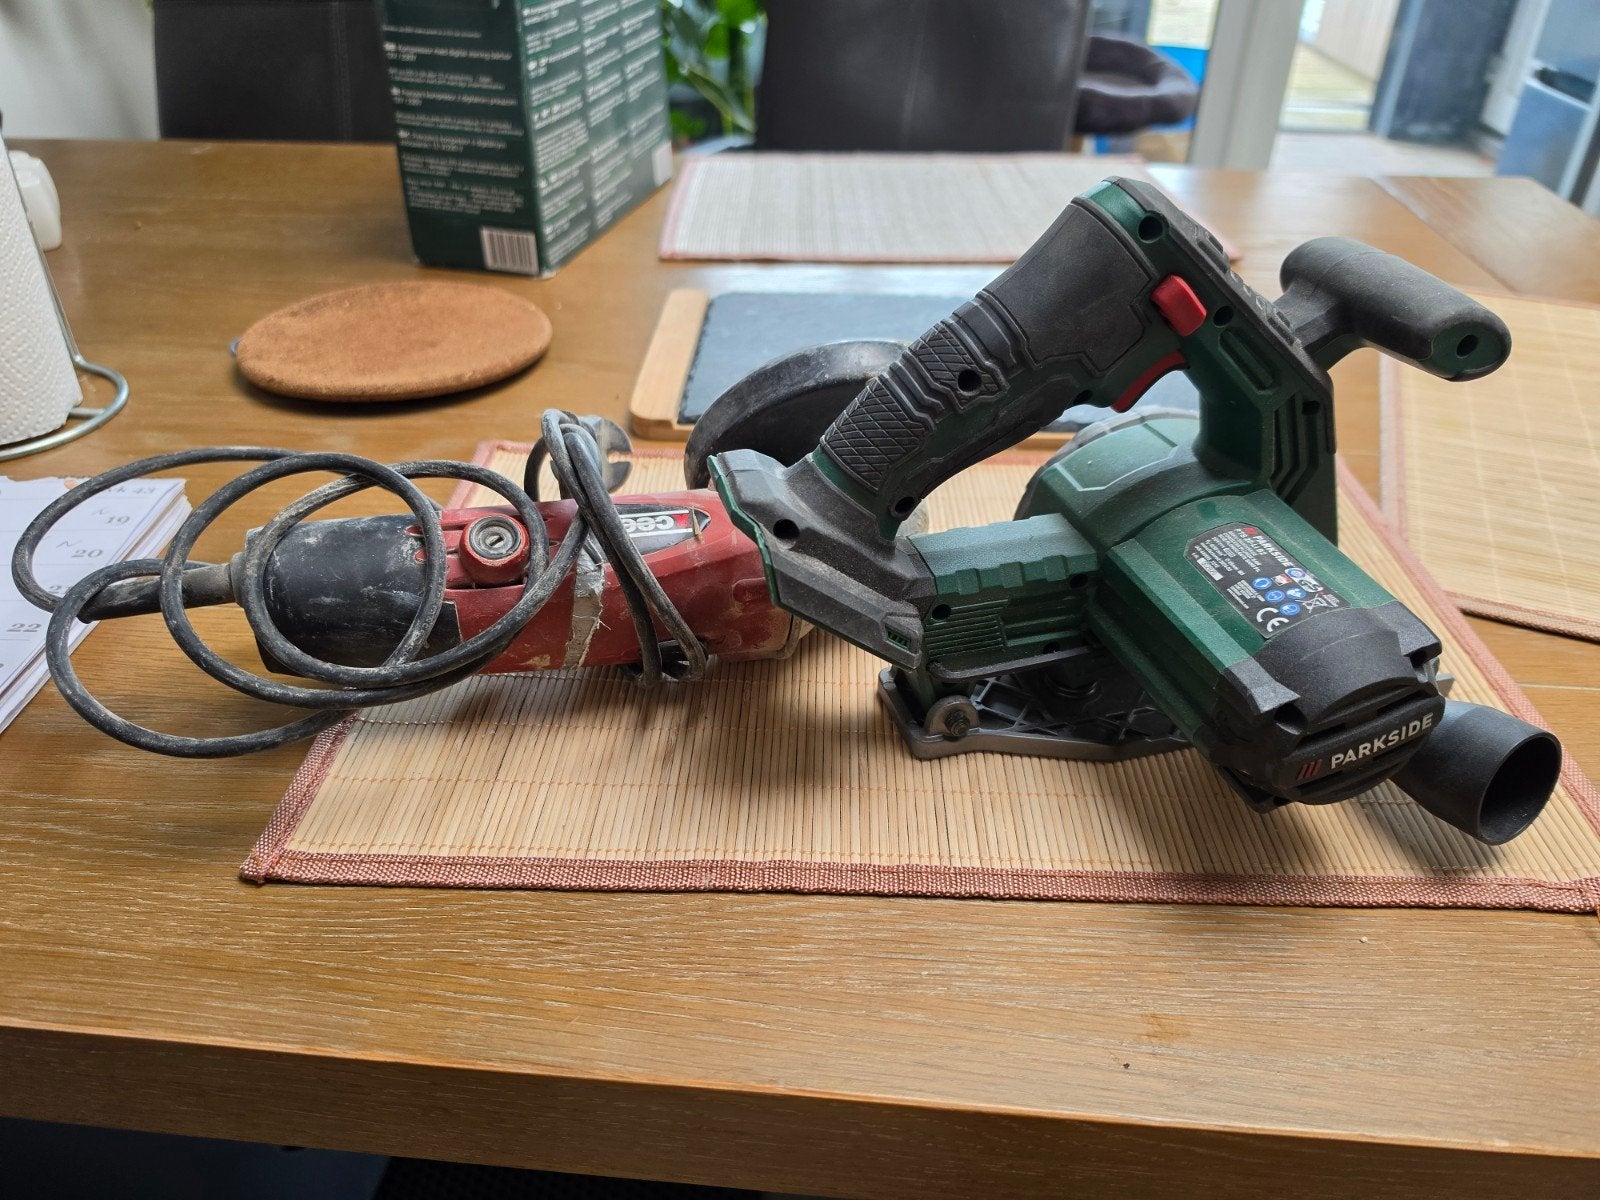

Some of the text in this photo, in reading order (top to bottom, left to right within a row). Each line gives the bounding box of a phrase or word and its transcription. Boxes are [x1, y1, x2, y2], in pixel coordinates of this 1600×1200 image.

[106, 514, 131, 525] 19
[620, 514, 691, 532] xcee
[71, 548, 104, 558] 20
[1252, 535, 1294, 567] PARKSIDE
[7, 622, 42, 633] 22
[1330, 712, 1434, 769] PARKSIDE
